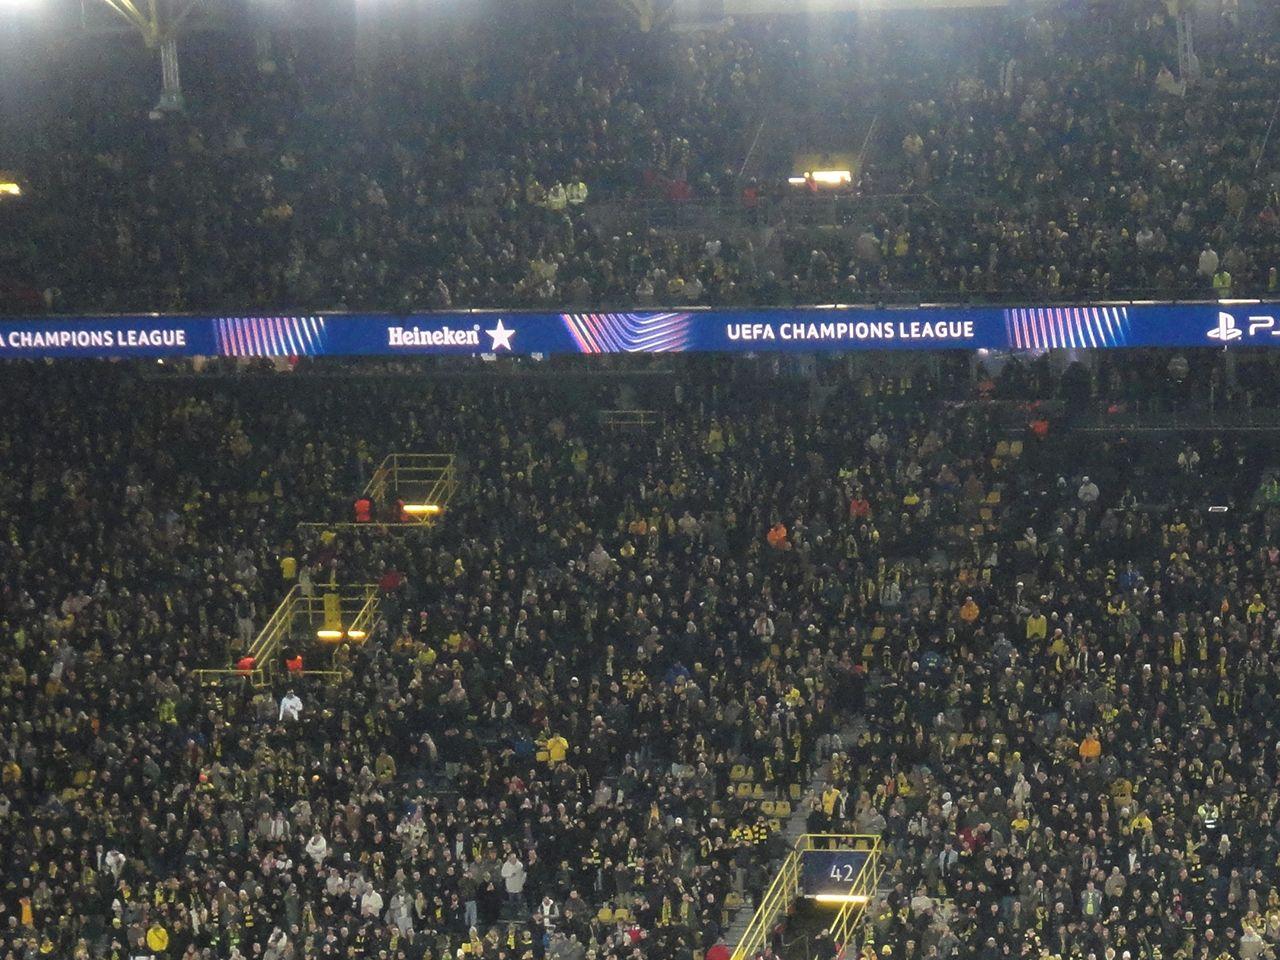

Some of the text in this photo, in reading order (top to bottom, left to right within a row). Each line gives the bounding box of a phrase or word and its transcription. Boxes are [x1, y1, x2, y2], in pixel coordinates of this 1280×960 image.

[8, 330, 114, 347] CHAMPIONS
[117, 329, 186, 346] LEAGUE
[388, 326, 480, 345] Heineken
[727, 320, 974, 339] UEFA CHAMPIONS LEAGUE
[830, 864, 854, 882] 42
